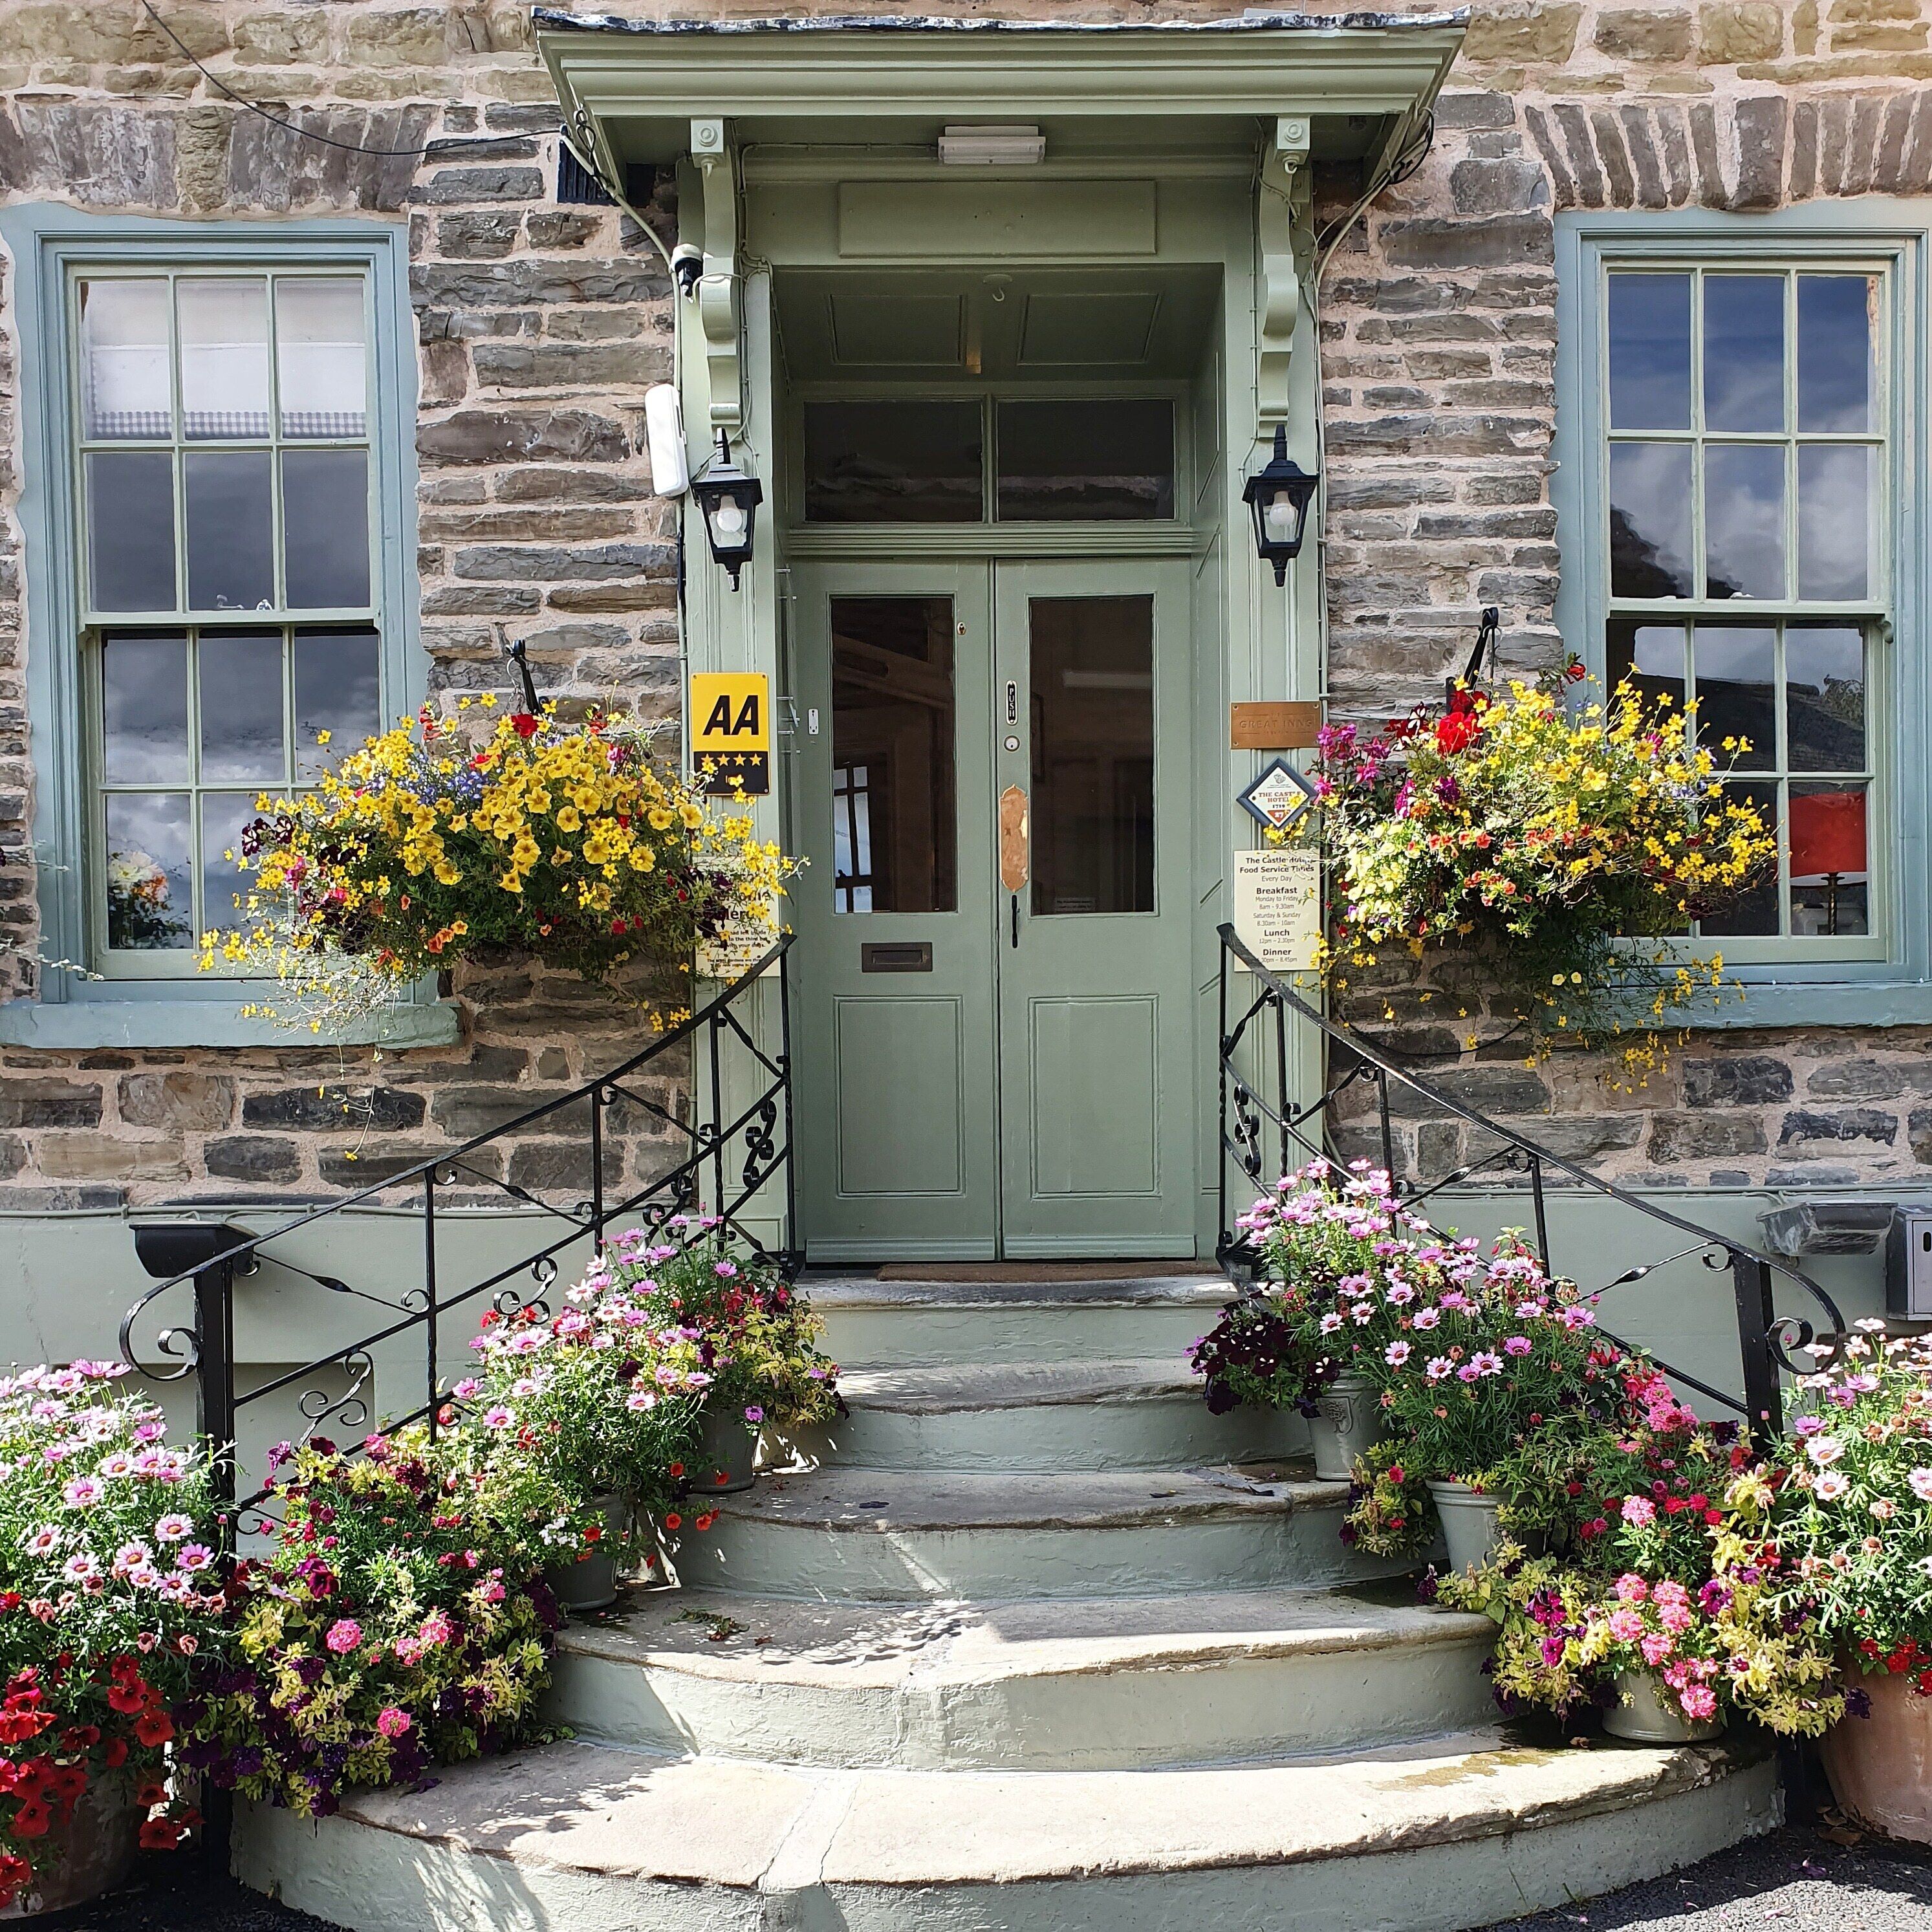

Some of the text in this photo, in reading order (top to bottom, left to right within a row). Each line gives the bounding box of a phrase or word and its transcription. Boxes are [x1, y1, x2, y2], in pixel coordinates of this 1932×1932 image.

[702, 695, 759, 735] AA
[1239, 719, 1313, 728] GREAT INNS
